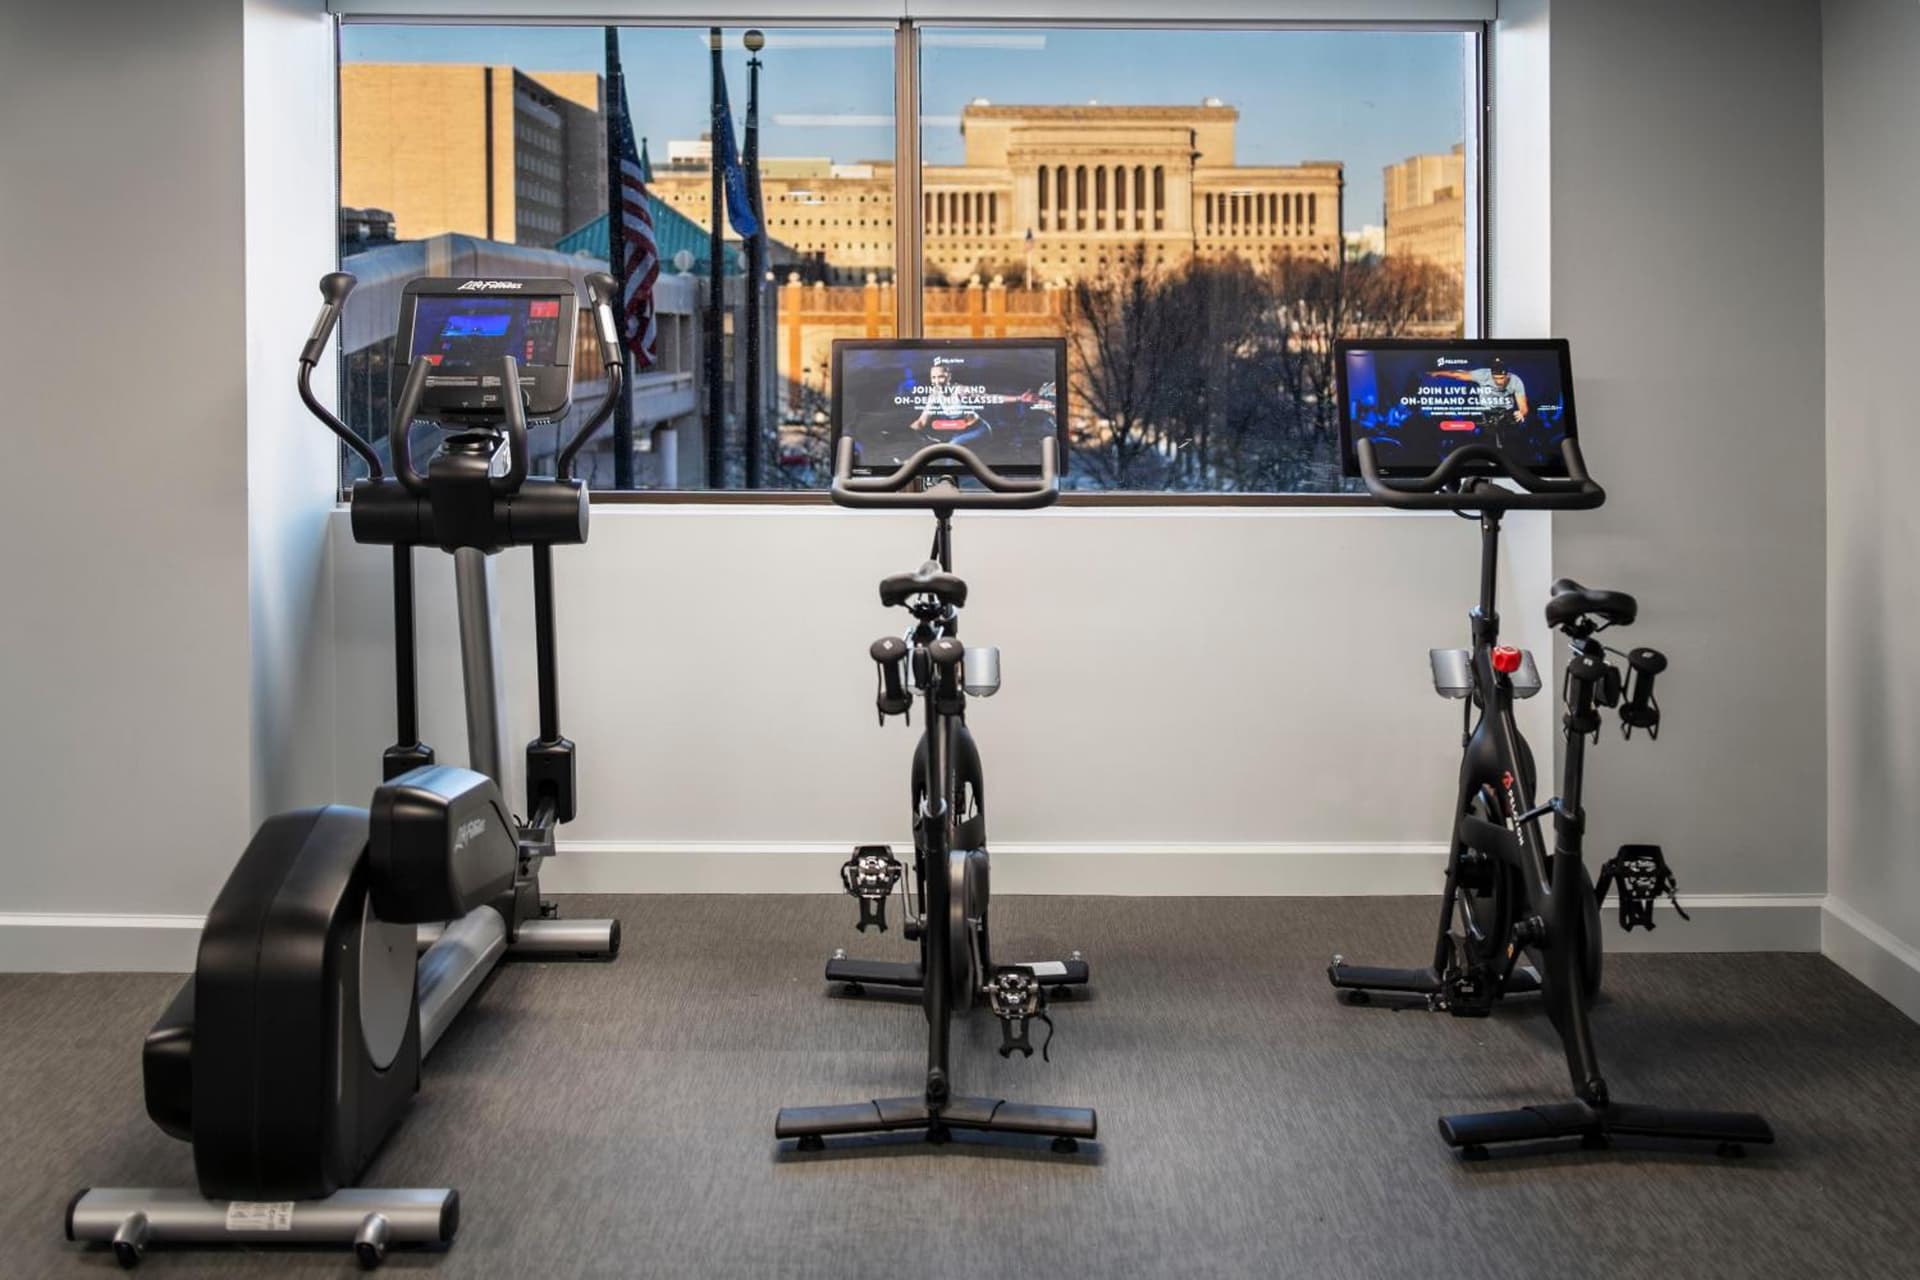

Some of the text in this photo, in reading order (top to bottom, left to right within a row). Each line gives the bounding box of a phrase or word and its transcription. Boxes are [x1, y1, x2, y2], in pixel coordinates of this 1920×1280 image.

[911, 385, 986, 394] JOIN LIVE AND
[1417, 386, 1492, 395] JOIN LIVE AND
[894, 396, 1005, 405] ON-DEMAND CLASSES
[1400, 396, 1511, 405] ON-DEMAND CLASSES
